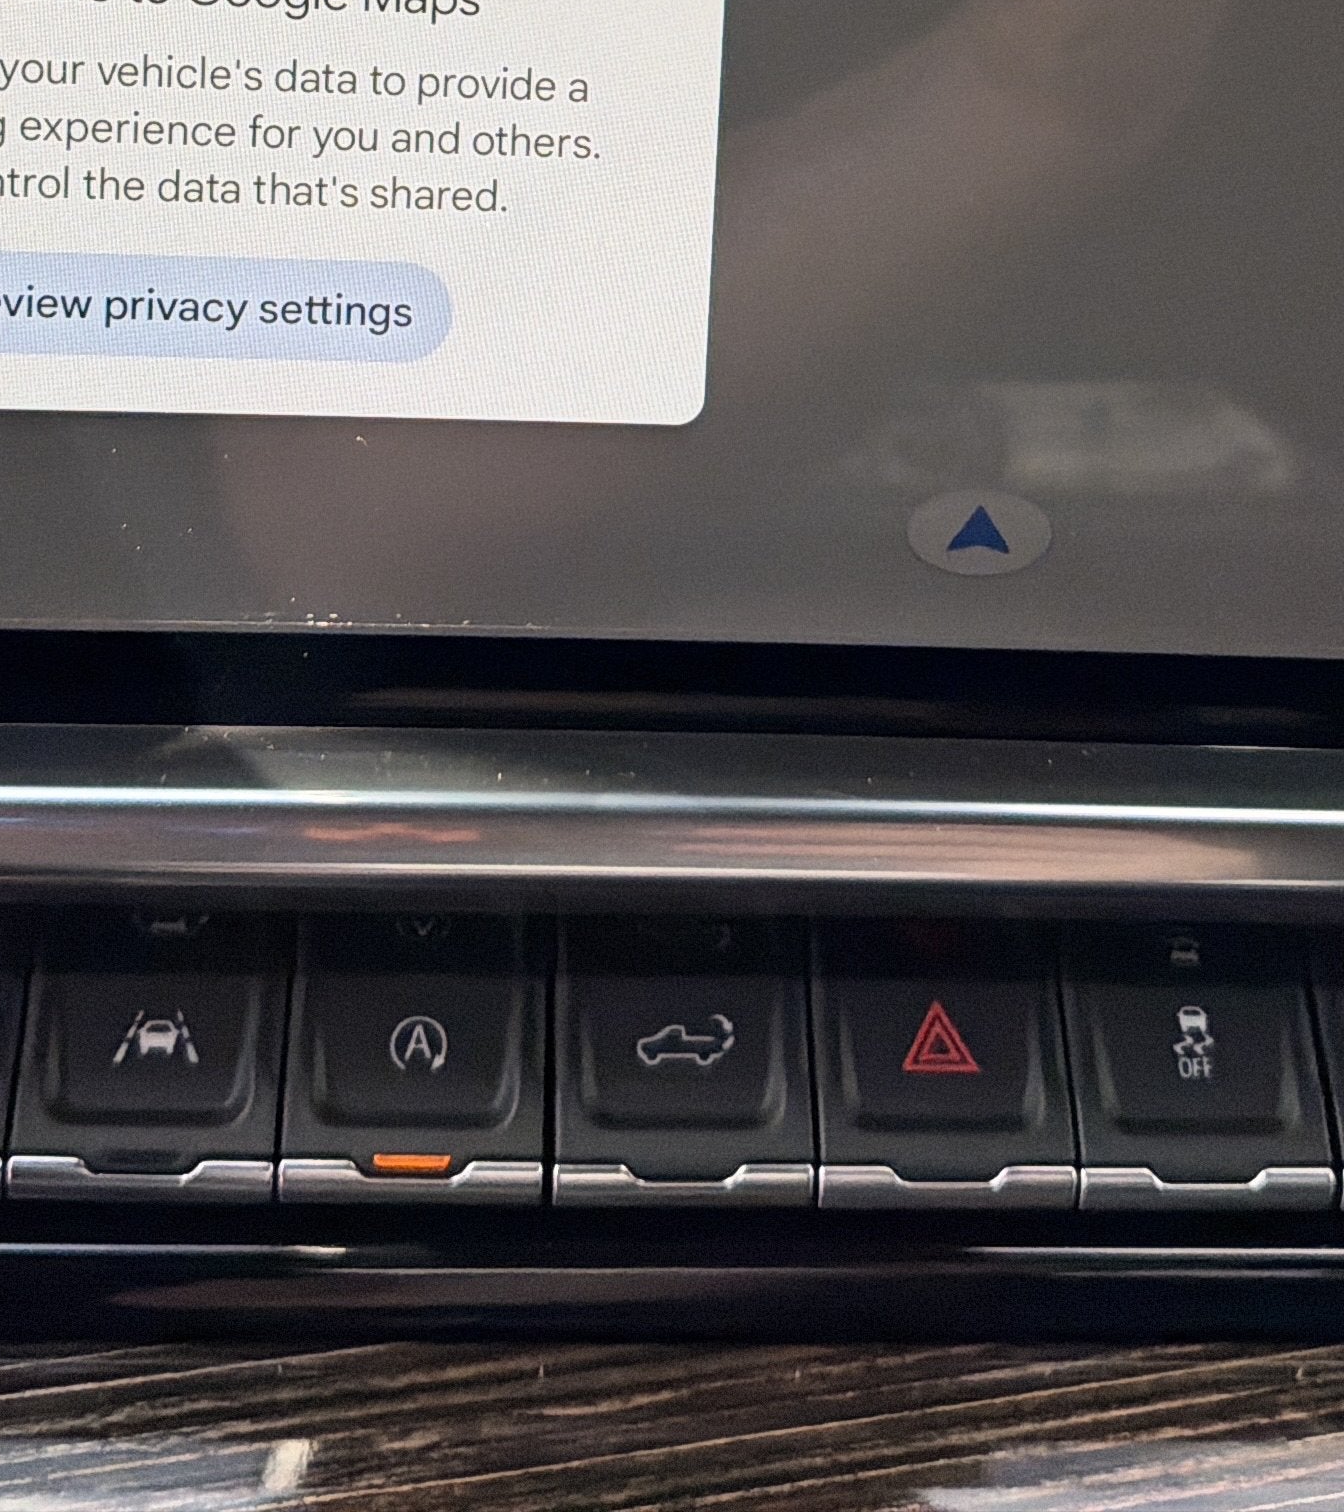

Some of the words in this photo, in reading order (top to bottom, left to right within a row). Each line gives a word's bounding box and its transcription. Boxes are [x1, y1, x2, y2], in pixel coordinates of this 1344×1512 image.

[97, 53, 264, 92] vehicle's
[274, 59, 358, 95] data
[370, 66, 407, 97] to
[417, 66, 557, 106] provide
[568, 78, 589, 103] a
[19, 110, 237, 151] experience
[249, 113, 301, 150] for
[312, 126, 379, 159] you
[390, 121, 461, 155] and
[472, 123, 600, 160] others.
[83, 166, 146, 202] the
[157, 168, 241, 205] data
[253, 172, 359, 209] that's
[370, 176, 507, 213] shared.
[103, 287, 248, 332] privacy
[259, 292, 413, 337] settings
[404, 1024, 432, 1062] A
[1178, 1056, 1212, 1079] OFF
